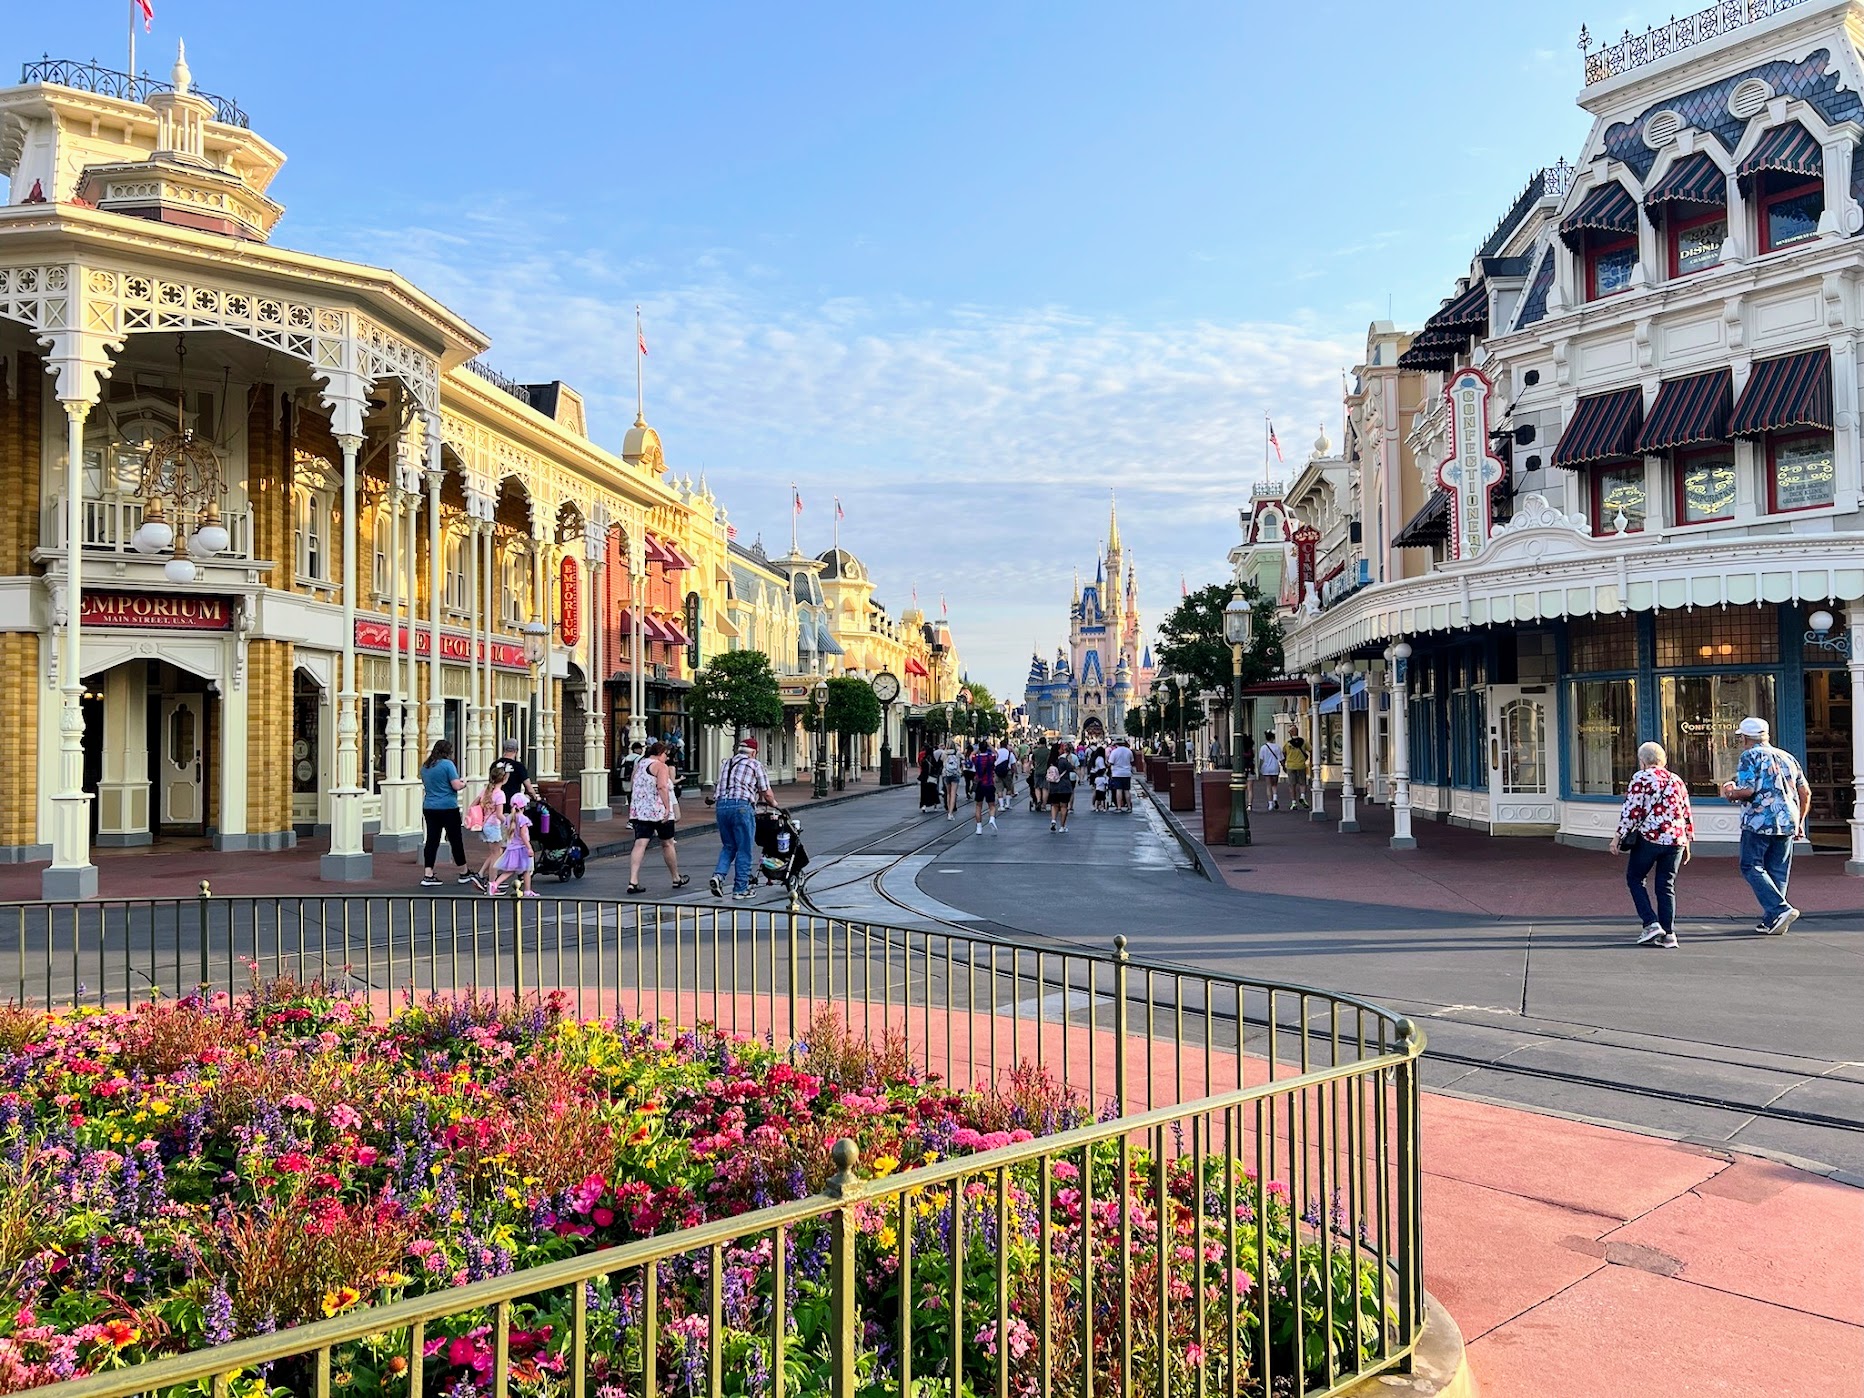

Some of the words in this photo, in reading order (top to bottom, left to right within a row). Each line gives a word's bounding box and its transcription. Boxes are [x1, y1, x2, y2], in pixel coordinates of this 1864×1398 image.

[1679, 242, 1721, 260] DISN
[1463, 390, 1481, 558] CONFECTIONERY
[1686, 484, 1736, 503] CORPORATION
[1301, 542, 1314, 581] CINE
[80, 595, 221, 620] EMPORIUM
[562, 564, 575, 637] EMPORIUM
[103, 615, 129, 623] MAIN
[689, 597, 697, 663] ARCADE
[416, 633, 505, 661] EPOIM
[1681, 721, 1740, 734] CONFECTION
